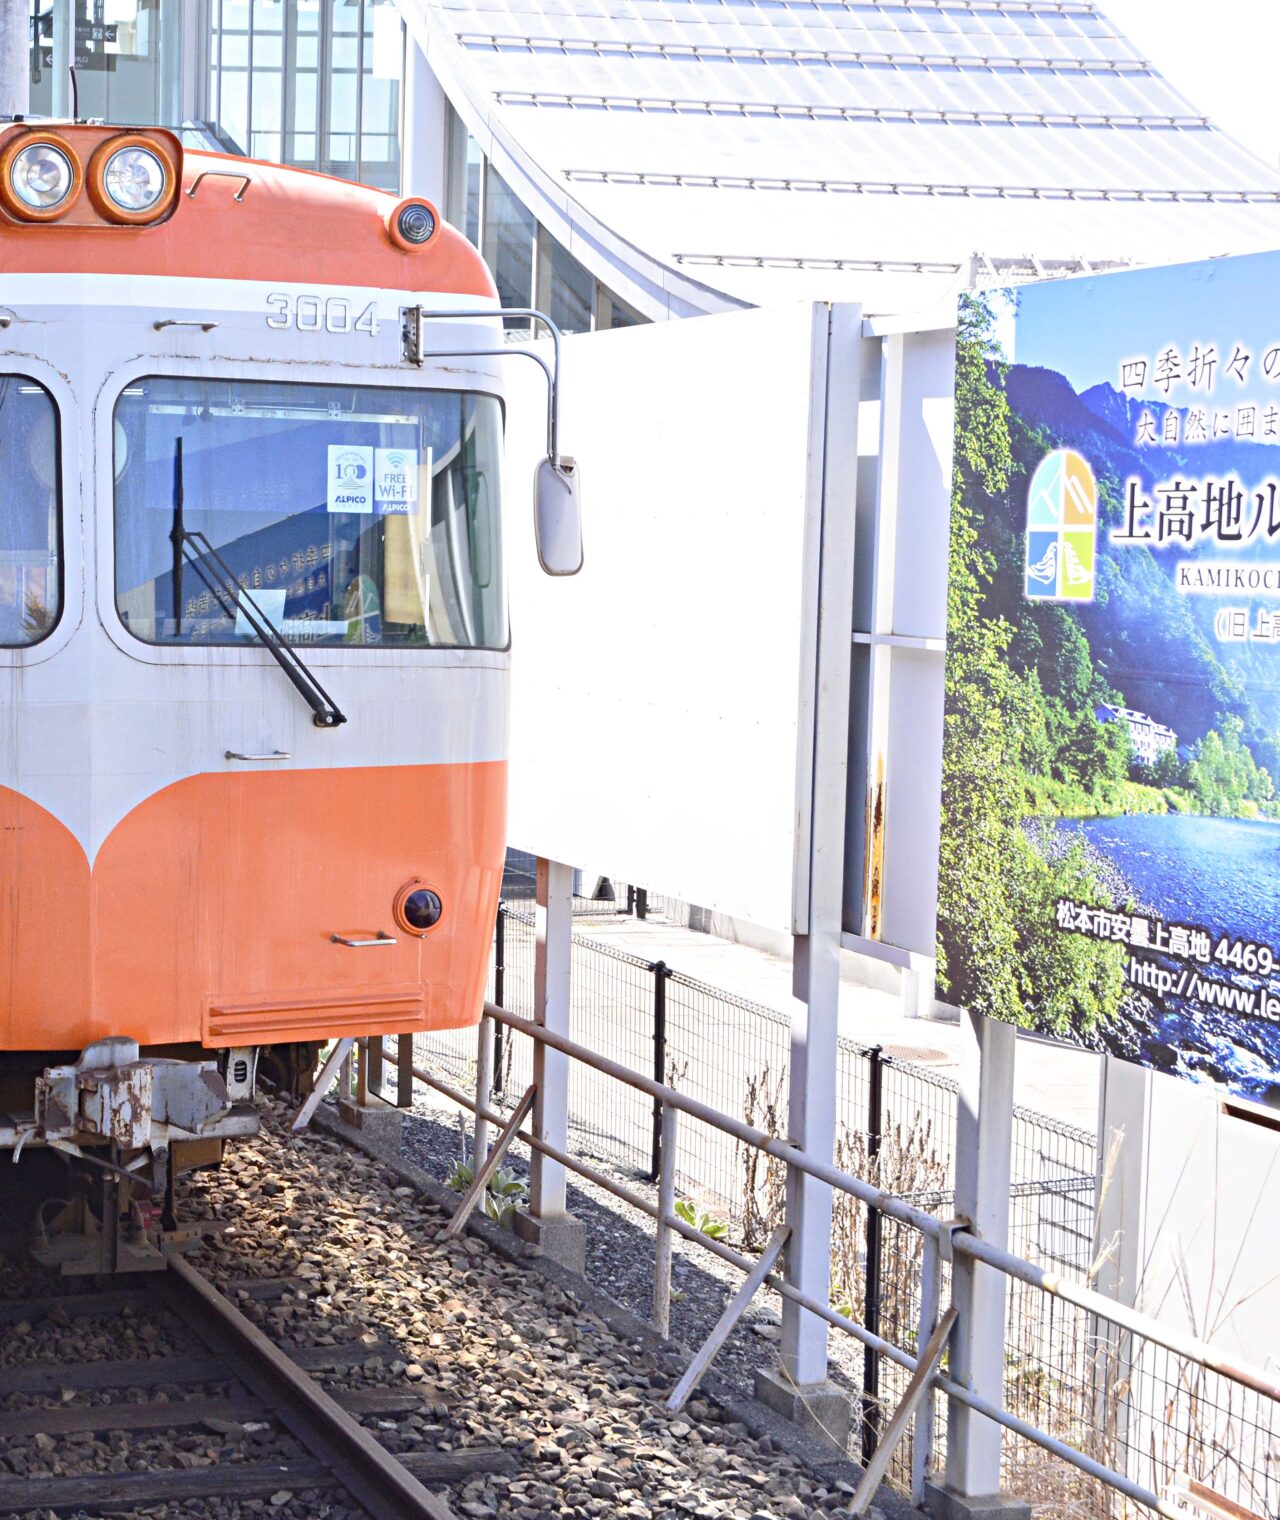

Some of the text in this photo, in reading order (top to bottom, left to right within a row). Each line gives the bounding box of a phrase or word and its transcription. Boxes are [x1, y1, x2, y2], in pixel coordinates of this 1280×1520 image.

[266, 293, 380, 337] 3004
[1122, 346, 1280, 393] 四季折々の
[1137, 406, 1278, 442] 大自然に囲ま
[379, 484, 412, 498] Wi-Fi
[384, 473, 408, 483] FREE
[335, 496, 366, 504] ALPICO
[383, 504, 409, 512] ALPICO
[1113, 480, 1280, 541] 上高地ル
[1180, 568, 1280, 588] KAMIKOC
[1057, 899, 1280, 975] 松本市安曇上高地 4469-
[1131, 956, 1280, 1020] http://www.le
